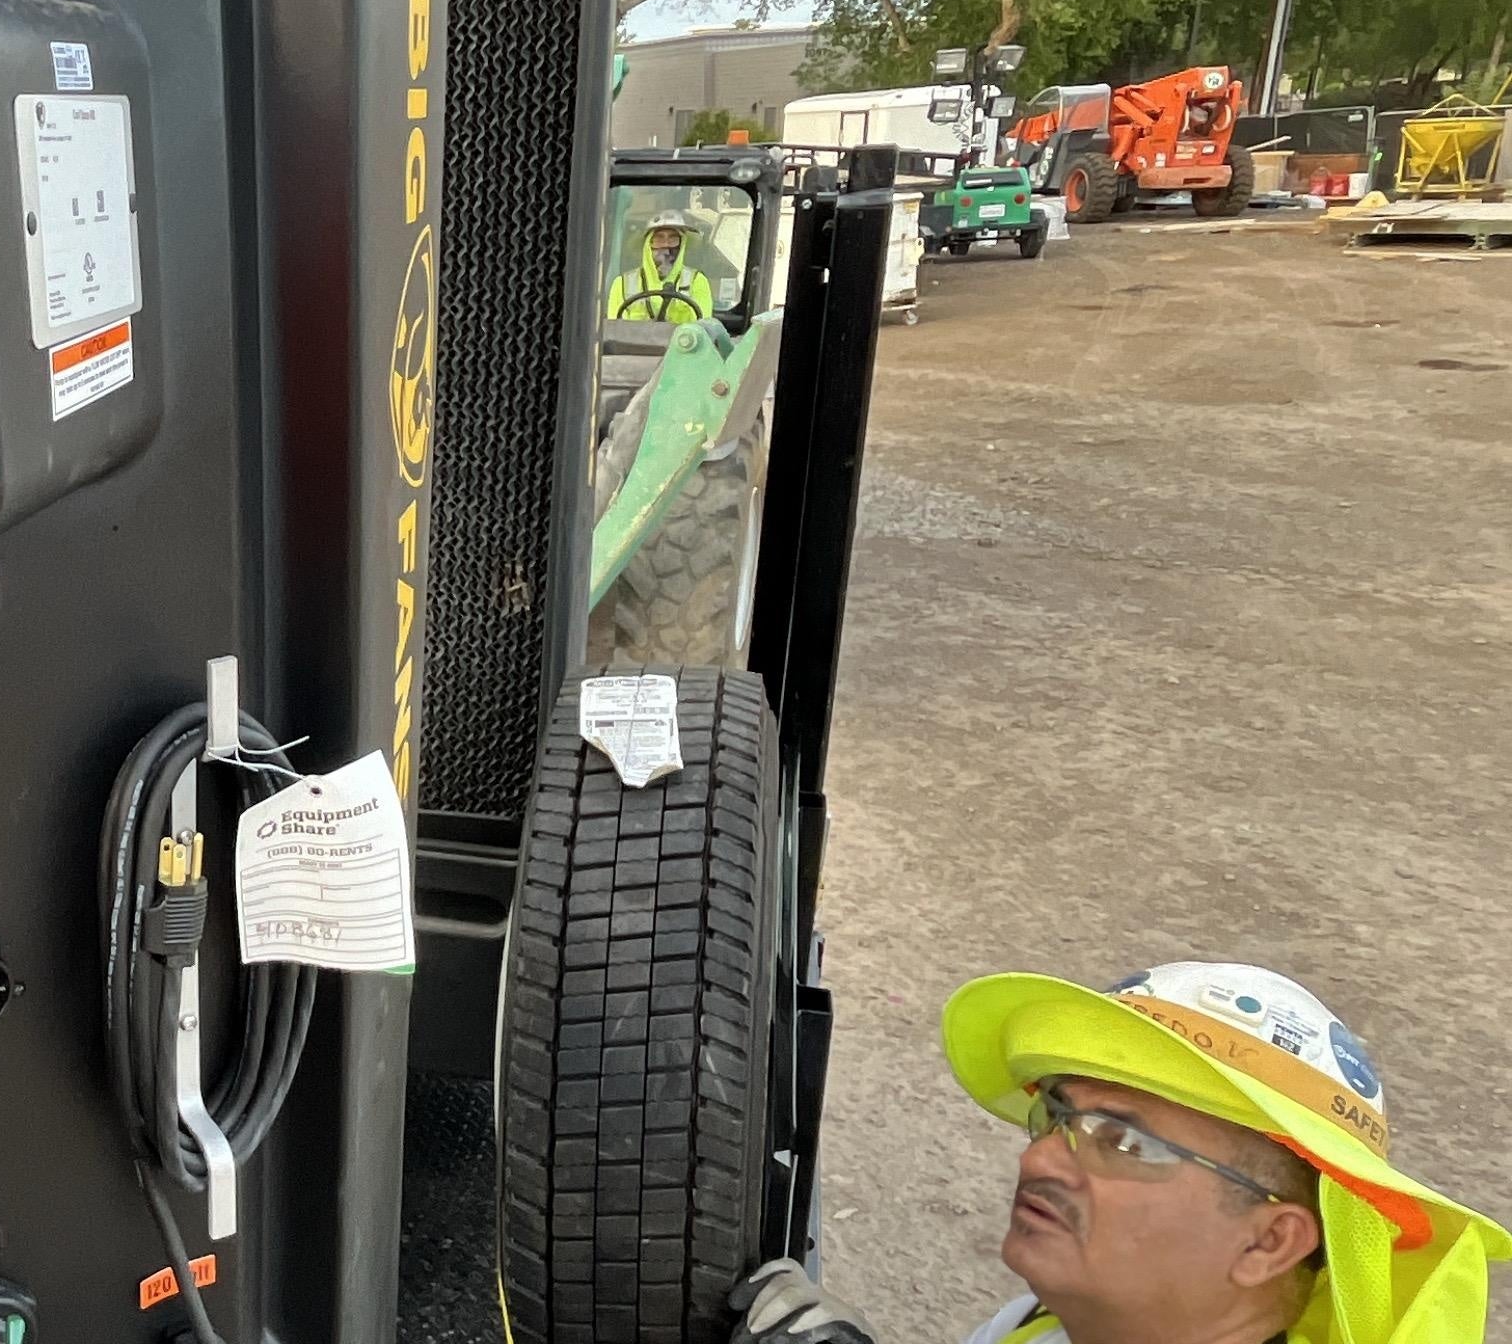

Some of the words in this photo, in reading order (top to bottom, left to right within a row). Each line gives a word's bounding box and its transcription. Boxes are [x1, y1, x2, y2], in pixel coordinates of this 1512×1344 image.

[393, 499, 417, 800] FANS
[281, 798, 379, 823] Equipment
[281, 822, 337, 836] Share
[146, 1276, 172, 1300] 120
